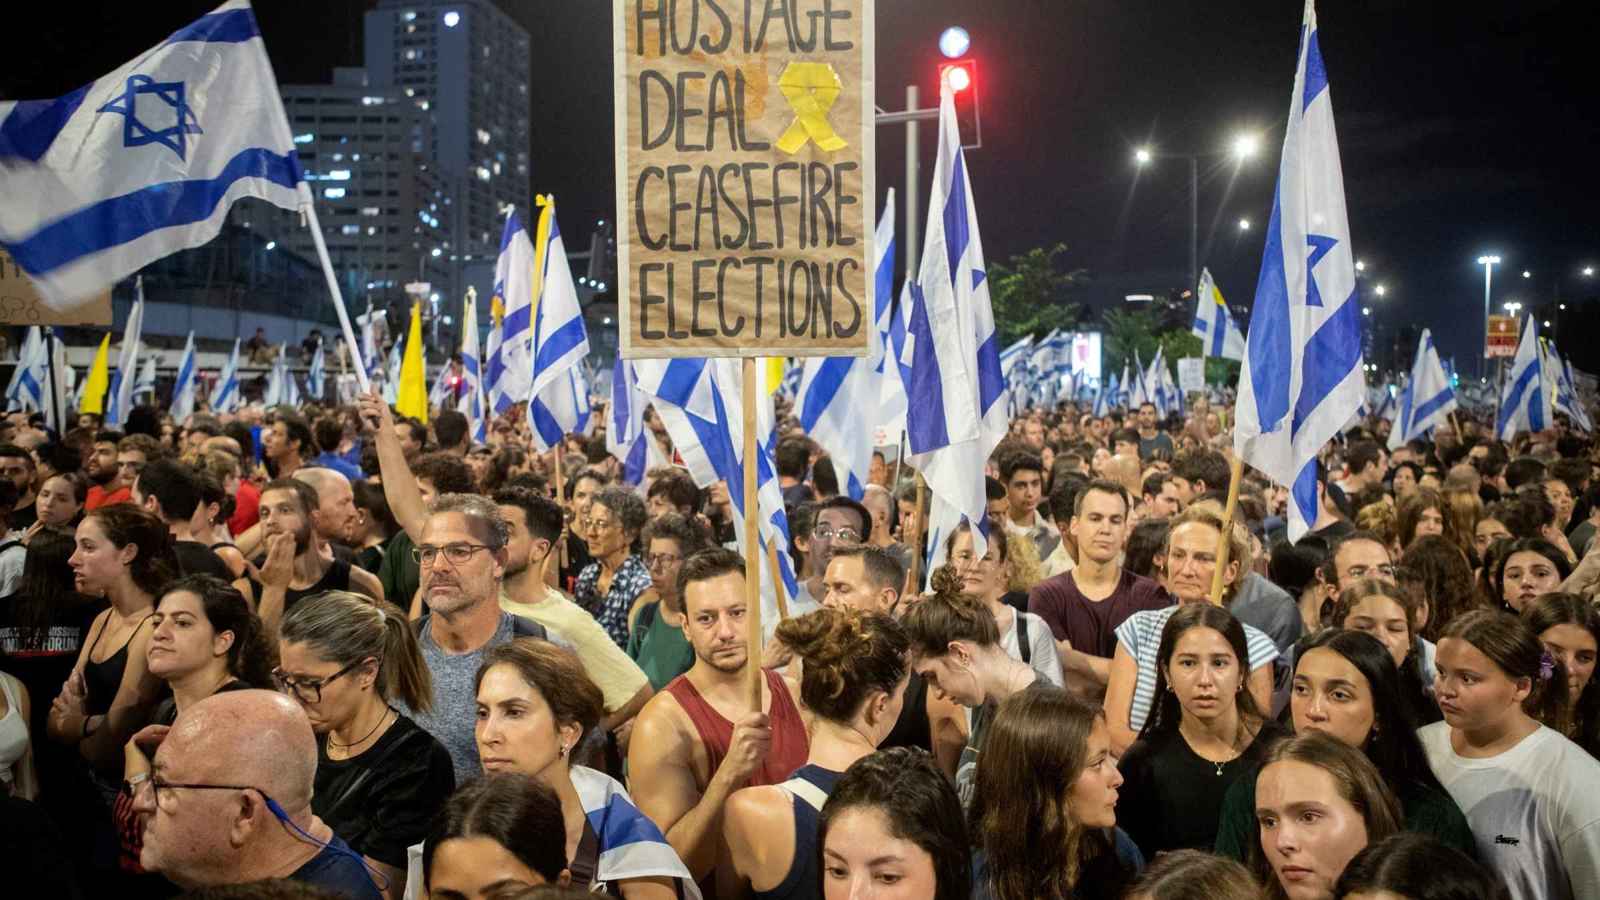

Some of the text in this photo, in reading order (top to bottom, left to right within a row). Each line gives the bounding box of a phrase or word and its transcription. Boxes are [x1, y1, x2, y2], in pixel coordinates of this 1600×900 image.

[636, 0, 853, 56] HOSTAGE
[639, 69, 771, 152] DEAL
[635, 161, 858, 251] CEASEFIRE
[639, 256, 861, 339] ELECTIONS
